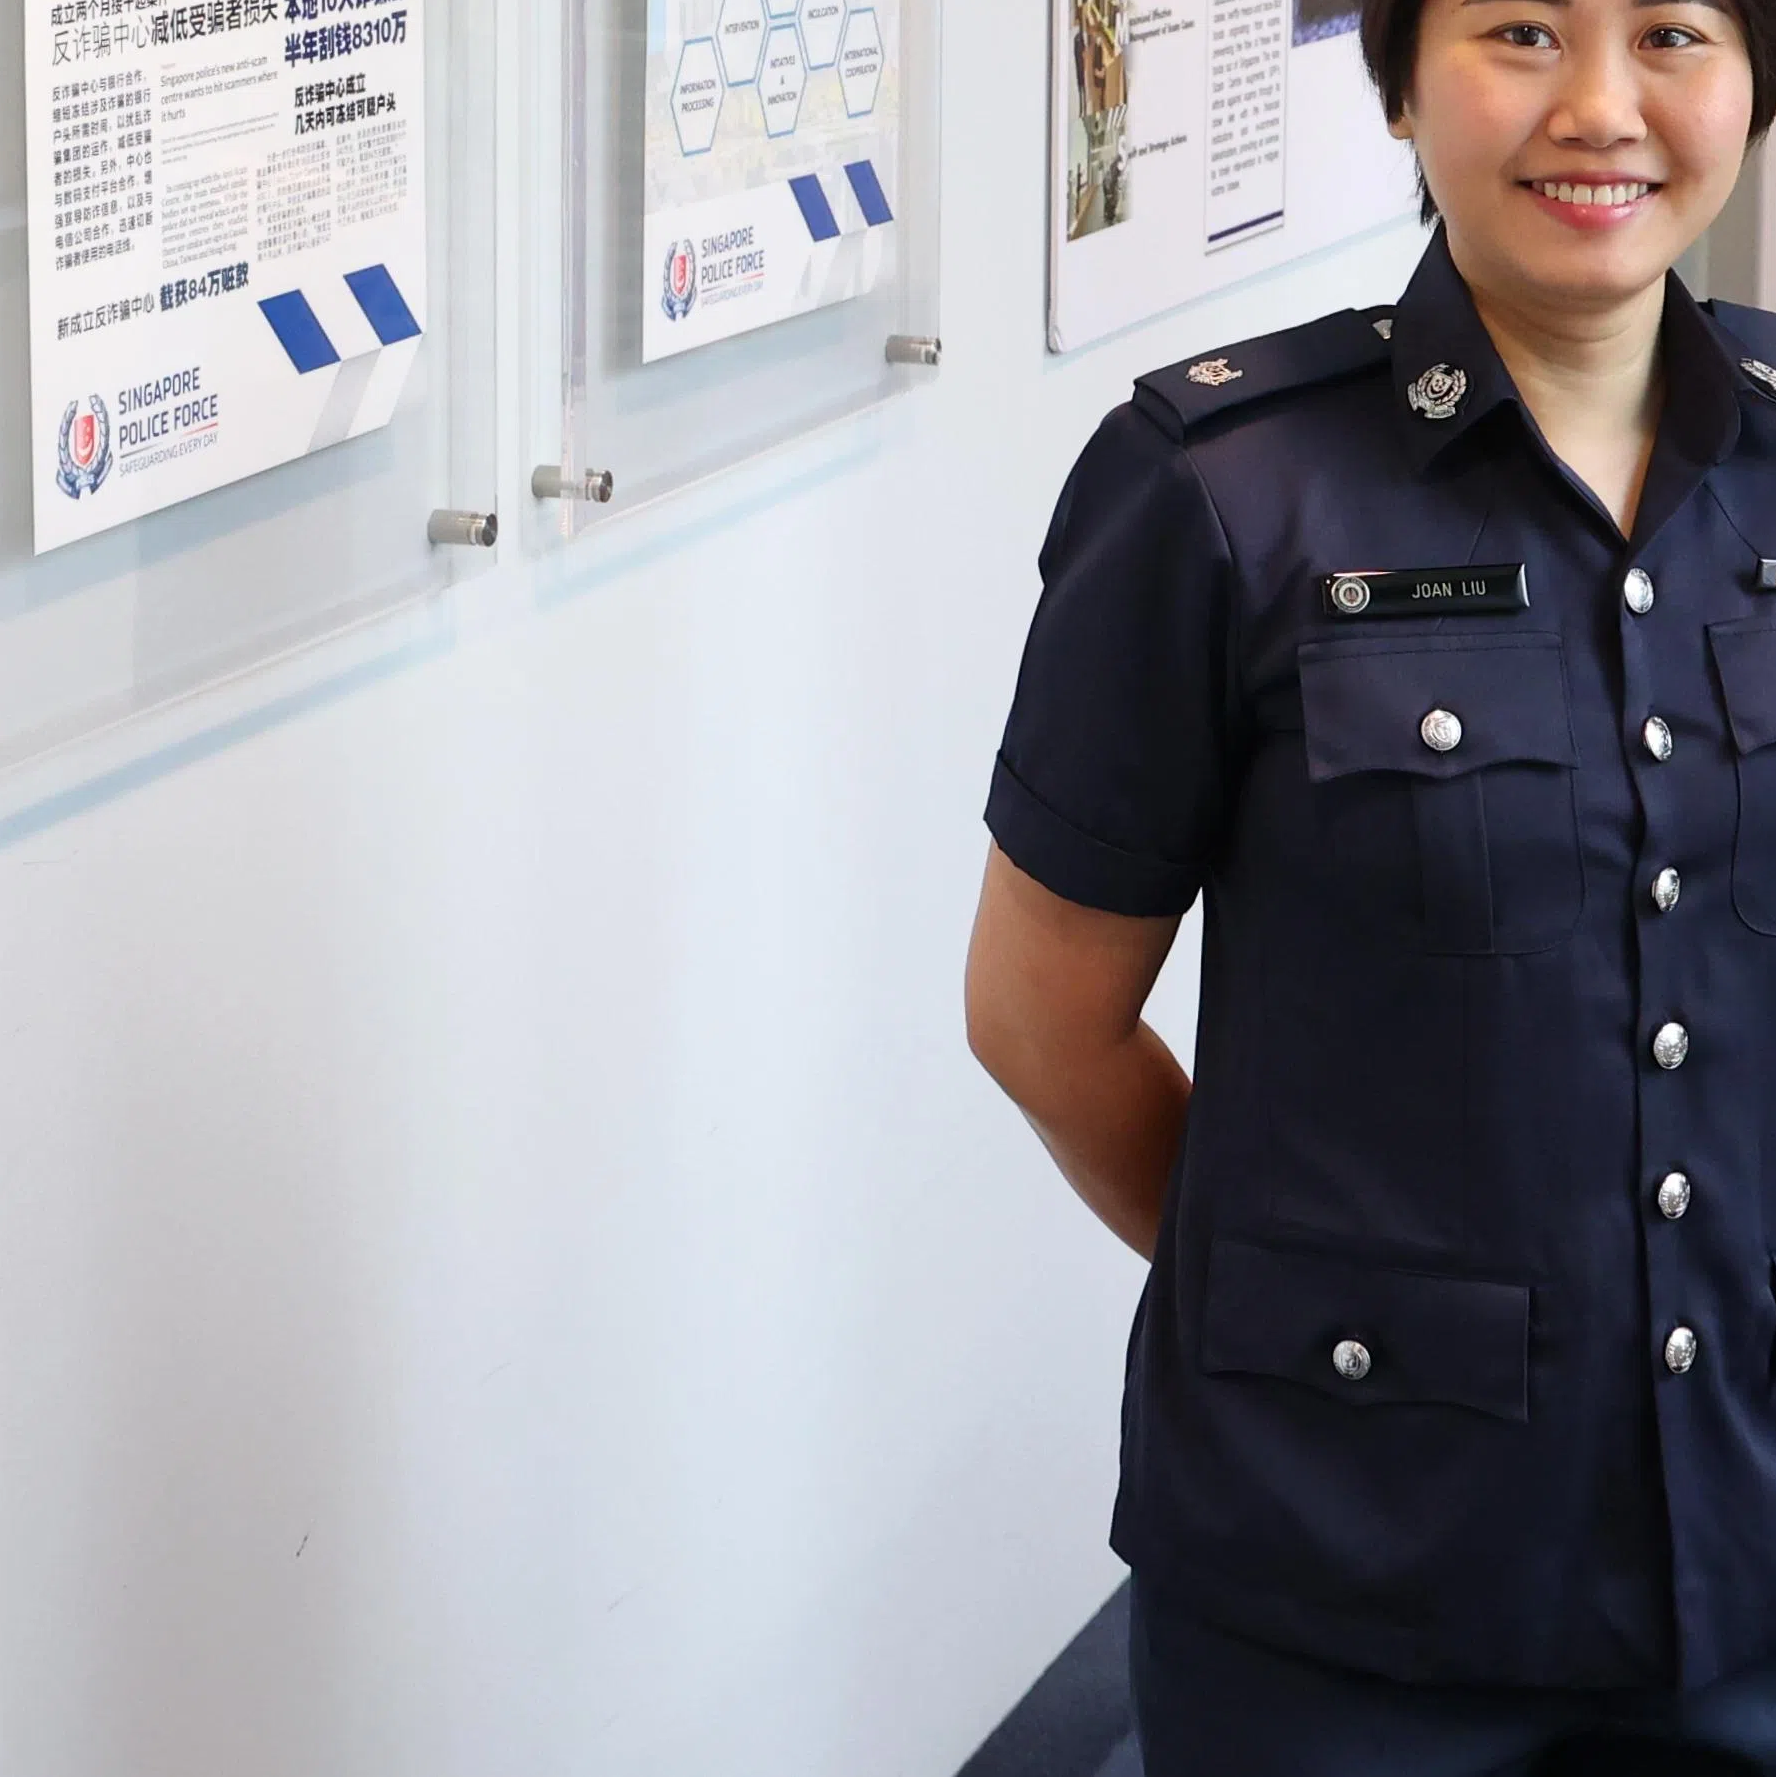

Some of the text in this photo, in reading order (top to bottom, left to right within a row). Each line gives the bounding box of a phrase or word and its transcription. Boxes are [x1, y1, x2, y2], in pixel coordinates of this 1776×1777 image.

[702, 226, 754, 258] SINGAPORE
[702, 250, 765, 285] POLICE FORCE
[118, 366, 201, 416] SINGAPORE
[119, 394, 219, 450] POLICE FORCE
[1412, 580, 1486, 599] JOAN LIU
